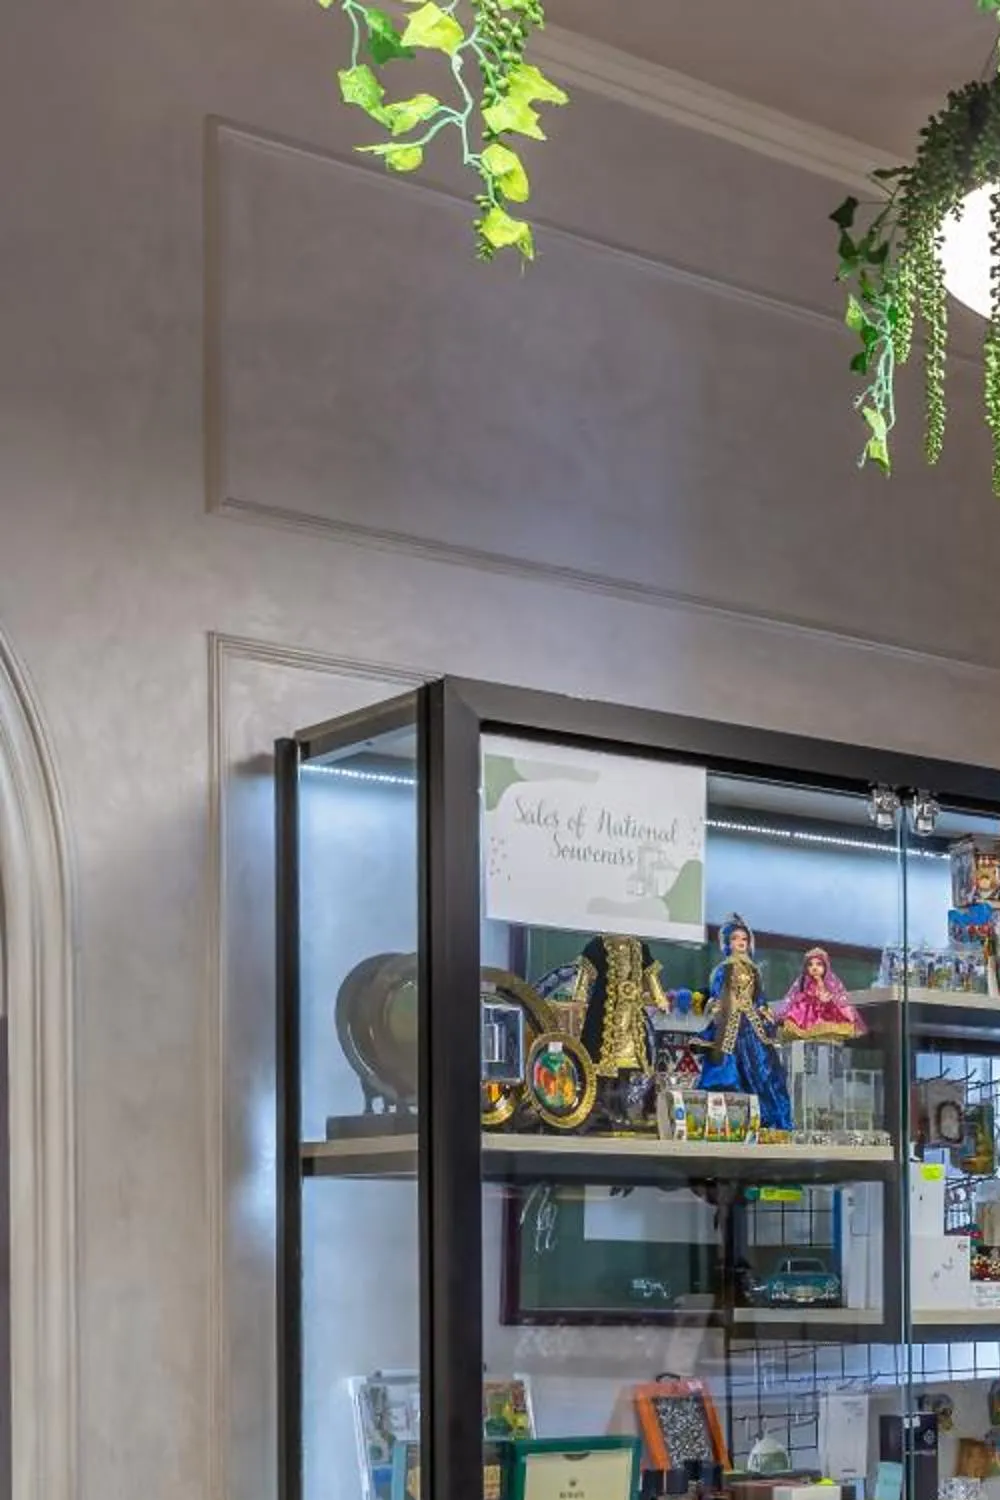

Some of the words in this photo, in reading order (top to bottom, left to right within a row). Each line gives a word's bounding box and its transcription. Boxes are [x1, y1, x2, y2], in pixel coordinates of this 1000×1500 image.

[513, 797, 560, 828] Sales
[567, 804, 587, 840] of
[597, 807, 677, 844] National
